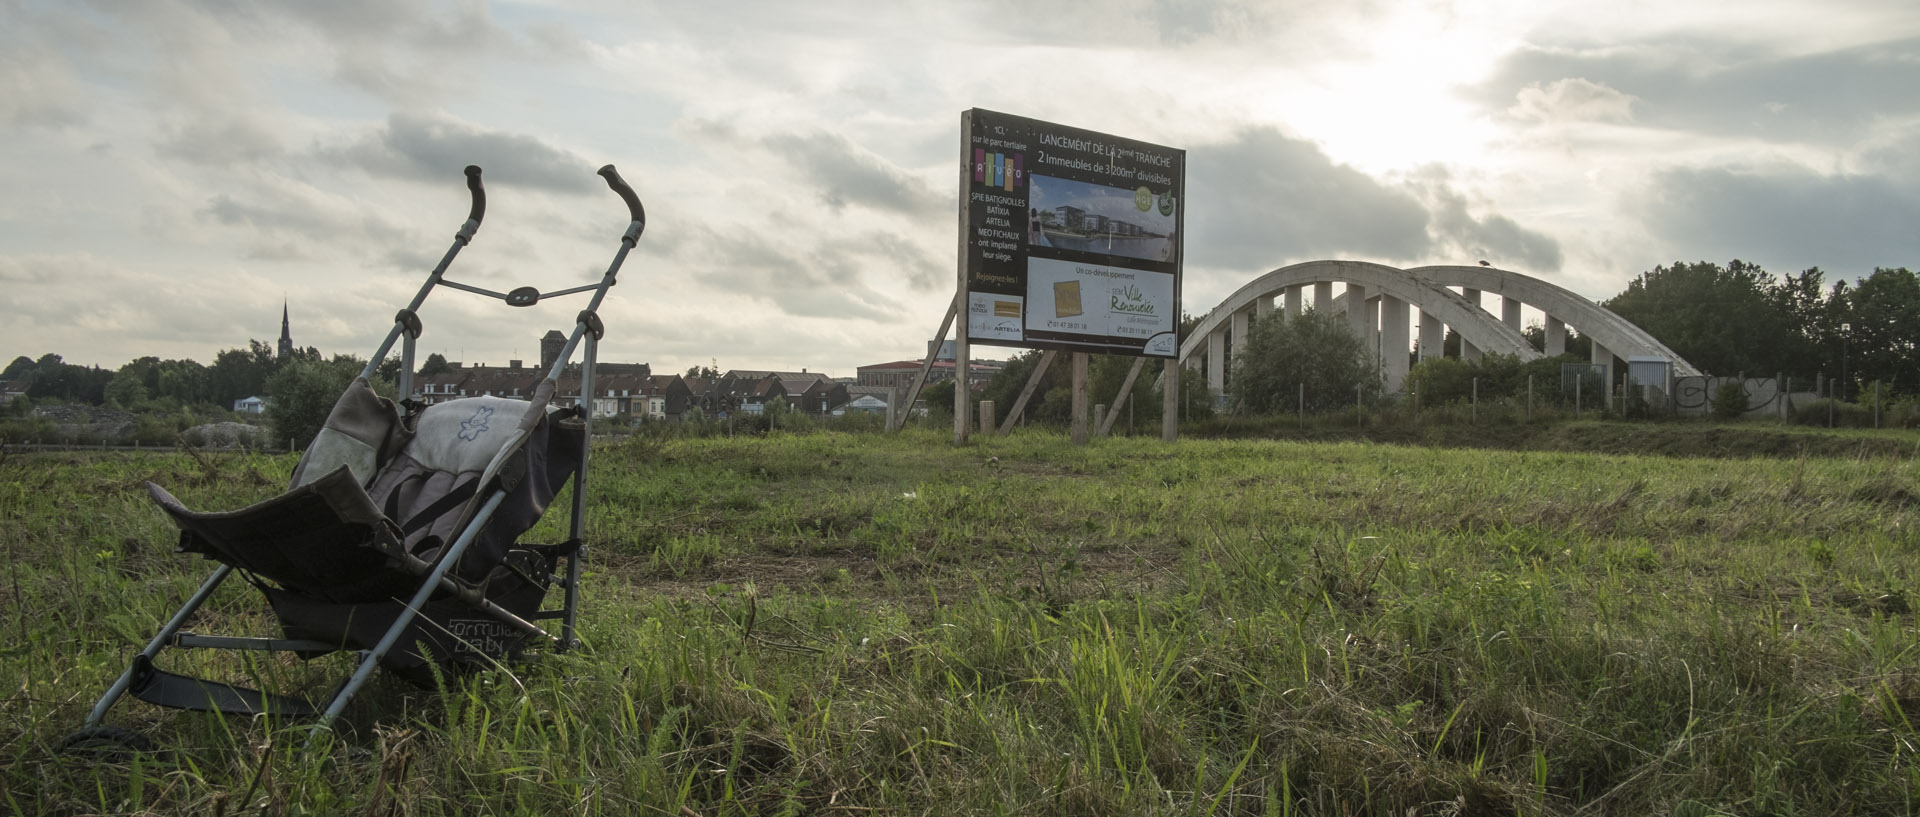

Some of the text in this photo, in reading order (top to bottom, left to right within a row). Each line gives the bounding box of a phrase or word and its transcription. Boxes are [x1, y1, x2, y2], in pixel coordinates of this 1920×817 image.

[983, 136, 989, 144] le
[990, 139, 1003, 148] parc
[1004, 141, 1027, 151] tertiaire
[1040, 133, 1090, 152] LANCEMENT
[1093, 143, 1104, 155] DE
[1106, 146, 1116, 157] LA
[1135, 152, 1171, 168] TRANCHE
[1038, 150, 1044, 162] 2
[1094, 162, 1104, 173] de
[1138, 170, 1172, 186] divisibles
[972, 192, 1026, 208] SPIE BATIGNOLLES
[986, 206, 1010, 216] BATIXIA
[986, 218, 1010, 228] ARTELIA
[978, 228, 1020, 240] MEO FICHAUX
[990, 240, 1018, 251] implanté
[983, 250, 1012, 262] leur siège.
[1124, 284, 1142, 302] Ville
